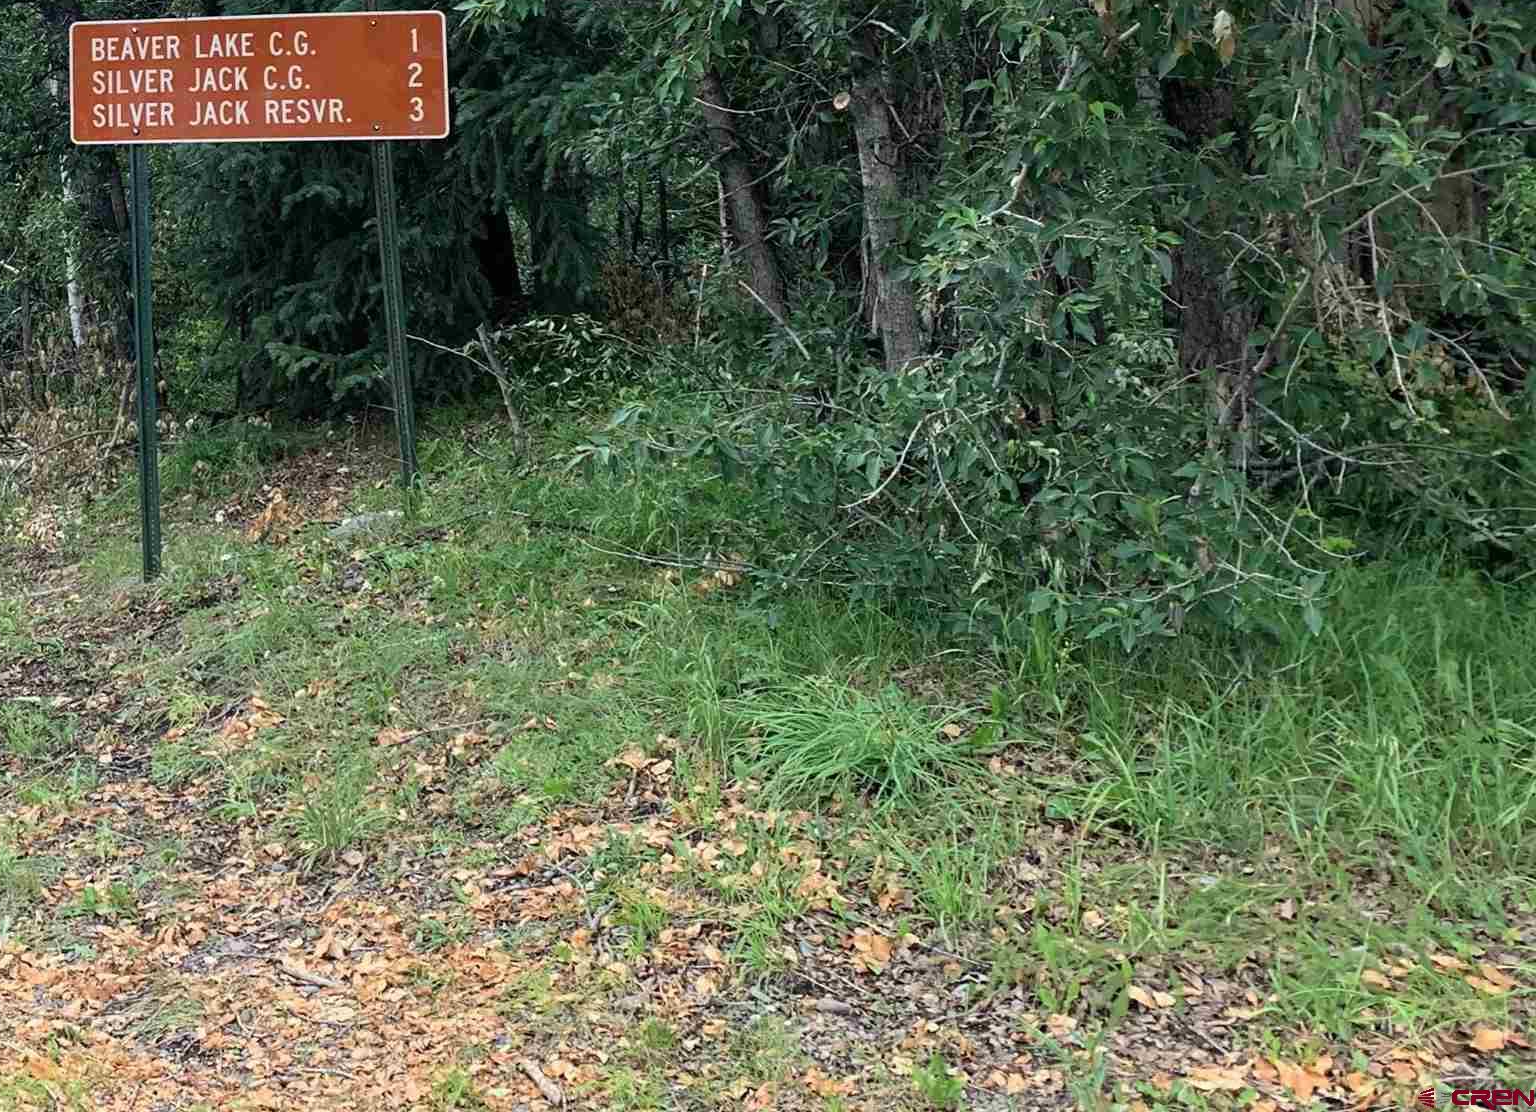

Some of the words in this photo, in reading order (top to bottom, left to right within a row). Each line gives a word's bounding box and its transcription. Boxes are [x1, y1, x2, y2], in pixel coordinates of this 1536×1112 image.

[91, 35, 180, 61] BEAVER
[195, 33, 255, 58] LAKE
[269, 31, 317, 57] C.G.
[409, 29, 420, 53] 1
[91, 69, 174, 95] SILVER
[188, 66, 249, 92] JACK
[263, 65, 311, 90] C.G.
[407, 62, 424, 88] 2
[92, 103, 175, 128] SILVER
[189, 100, 249, 126] JACK
[264, 98, 352, 124] RESVR.
[408, 96, 424, 122] 3
